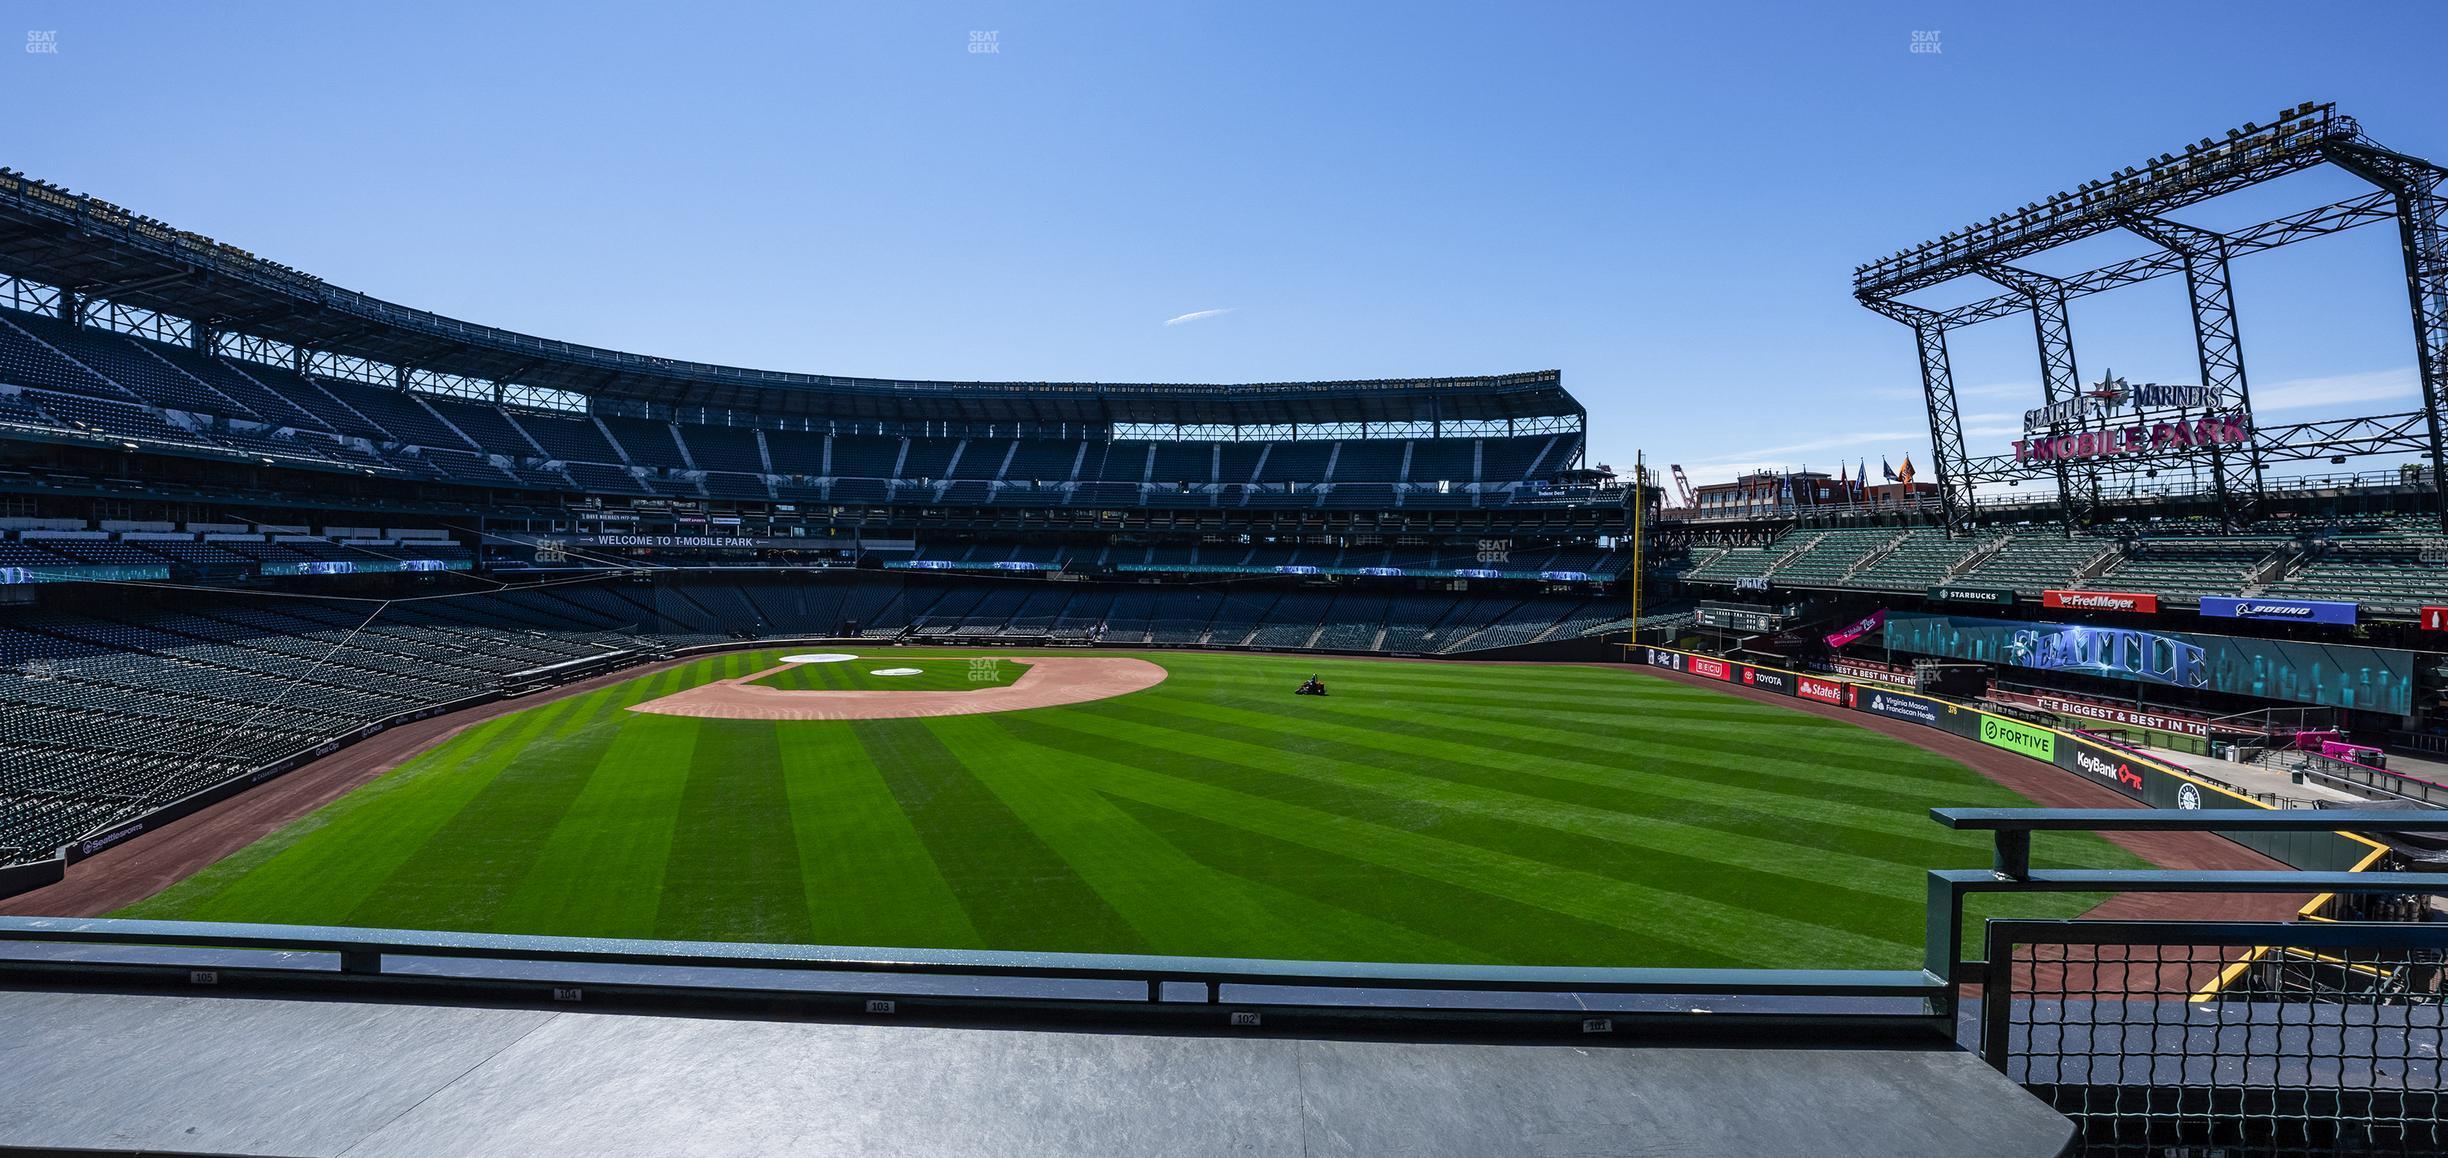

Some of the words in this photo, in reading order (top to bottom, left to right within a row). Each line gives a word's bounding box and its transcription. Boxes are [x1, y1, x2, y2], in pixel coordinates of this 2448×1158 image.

[2024, 396, 2092, 431] SEATTLE
[2132, 383, 2223, 408] MARINERS
[2012, 425, 2146, 463] T-MOBILE
[2151, 412, 2250, 450] PARK
[599, 535, 652, 546] WELCOME
[657, 536, 671, 546] TO
[675, 537, 722, 546] T-MOBILE
[725, 537, 752, 547] PARK
[1950, 591, 1997, 600] STARBUCKS
[2253, 605, 2310, 615] BOEING
[1698, 662, 1720, 674] BECU
[1756, 673, 1782, 686] TOYOTA
[1860, 669, 1879, 679] BEST
[1880, 673, 1888, 681] IN
[1890, 675, 1905, 684] THE
[1886, 696, 1908, 708] Virginia
[1908, 702, 1929, 712] Mason
[1885, 704, 1917, 717] Franciscan
[1917, 710, 1936, 722] Health
[2062, 701, 2113, 720] BIGGEST
[2116, 712, 2125, 722] &
[2129, 714, 2164, 728] BEST
[2168, 720, 2183, 731] IN
[1999, 727, 2049, 753] FORTIVE
[2077, 751, 2117, 780] KeyBank
[196, 972, 213, 983] 105
[559, 989, 577, 1000] 104
[872, 1002, 889, 1012] 103
[1238, 1014, 1255, 1024] 102
[1590, 1022, 1606, 1031] 101
